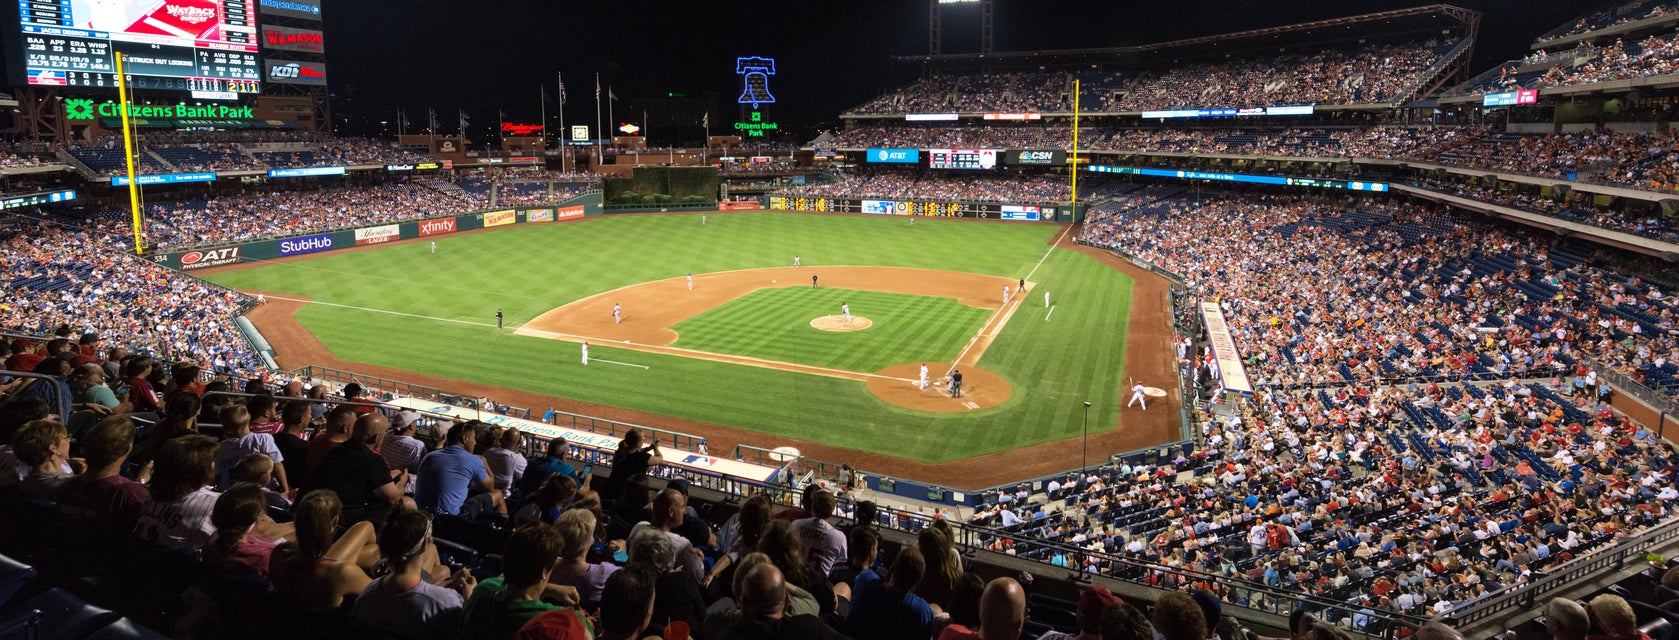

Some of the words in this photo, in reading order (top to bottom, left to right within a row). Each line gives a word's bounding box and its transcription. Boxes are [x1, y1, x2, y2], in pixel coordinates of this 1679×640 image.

[129, 57, 154, 65] STRUCK
[229, 82, 237, 92] 2
[240, 82, 247, 93] 1
[250, 83, 257, 93] 1
[176, 105, 217, 119] Bank
[219, 106, 254, 119] Park
[734, 121, 761, 130] Citizens
[761, 121, 778, 130] Bank
[889, 151, 907, 160] AT&T
[1032, 151, 1053, 160] CSN
[421, 221, 455, 237] xfinity
[281, 236, 332, 254] StubHub
[154, 254, 168, 263] 334
[201, 247, 239, 263] ATI
[182, 260, 211, 270] PHYSICAL
[211, 257, 238, 267] THERAPY
[507, 421, 557, 436] Citizens
[562, 432, 595, 445] Bank
[599, 439, 620, 449] Pa
